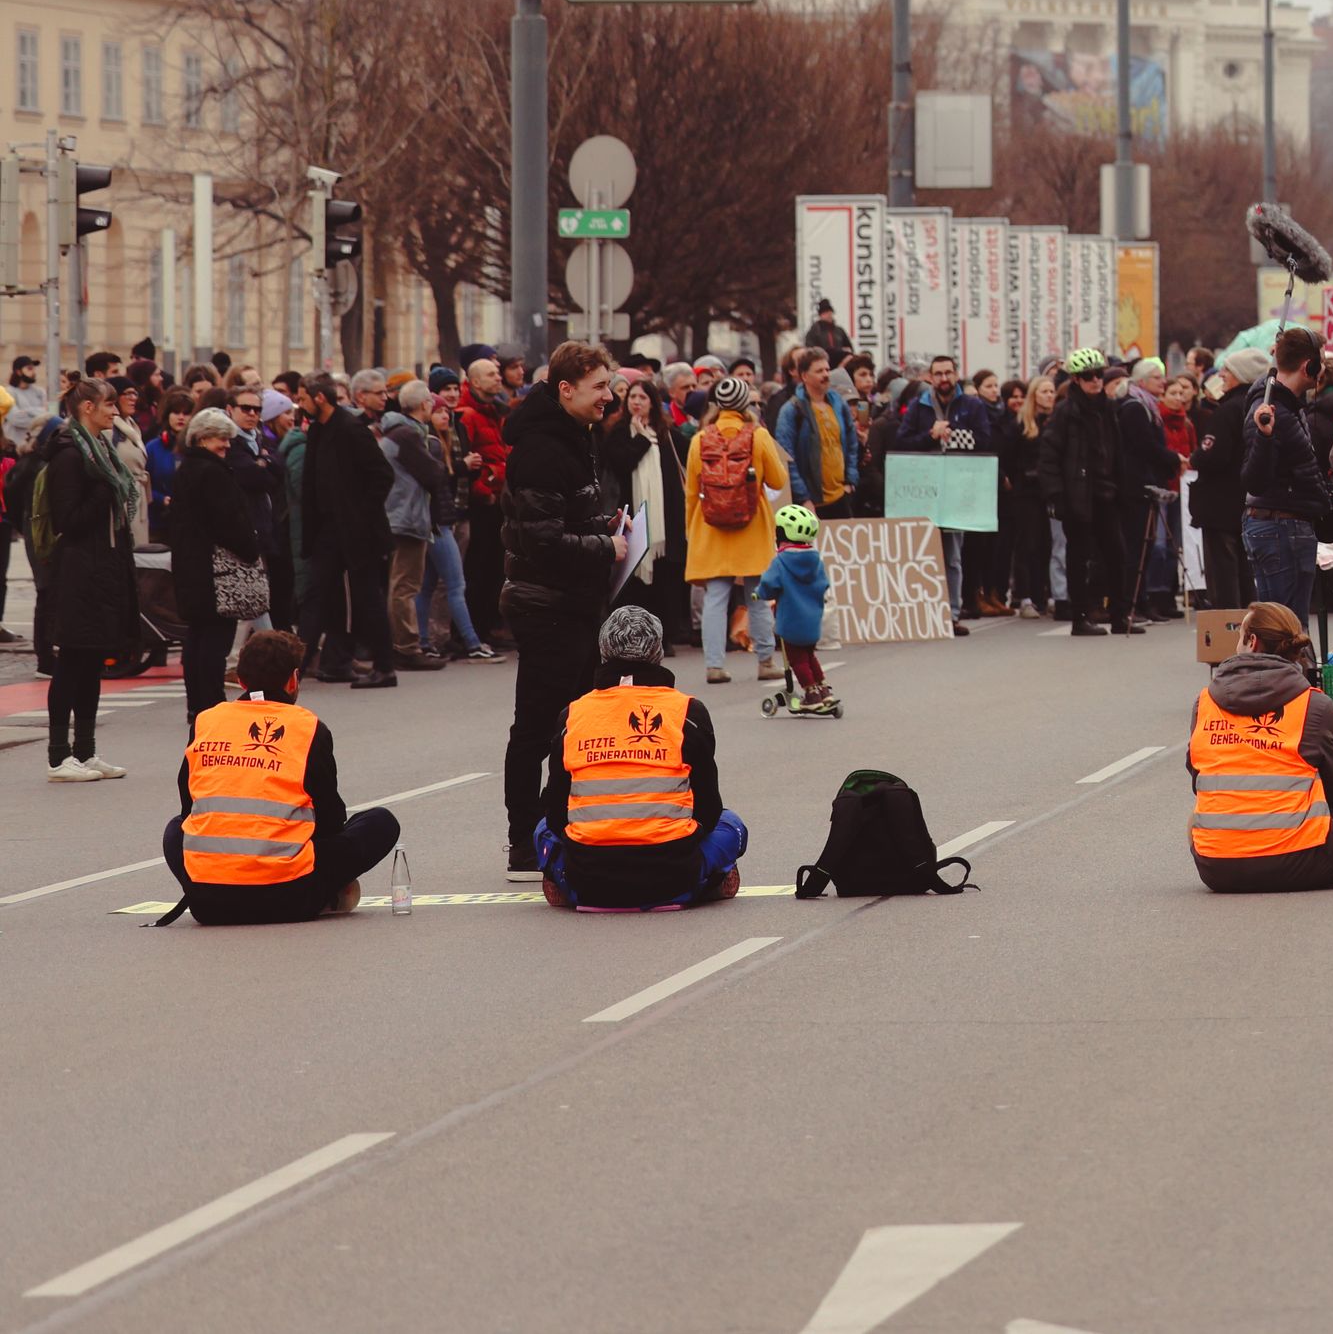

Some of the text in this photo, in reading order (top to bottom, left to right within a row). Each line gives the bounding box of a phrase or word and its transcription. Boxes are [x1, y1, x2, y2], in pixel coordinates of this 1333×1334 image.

[902, 219, 921, 316] karlsplatz
[924, 251, 941, 291] visit
[968, 228, 982, 320] karlsplatz
[986, 228, 1001, 344] freier eintritt
[813, 521, 937, 565] ASCHUTZ
[829, 560, 946, 605] PFUNGS-
[835, 601, 955, 642] TWORTUNG
[193, 741, 232, 753] LETZTE
[202, 753, 283, 772] GENERATION.AT
[578, 737, 616, 751] LETZTE
[586, 748, 669, 763] GENERATION.AT
